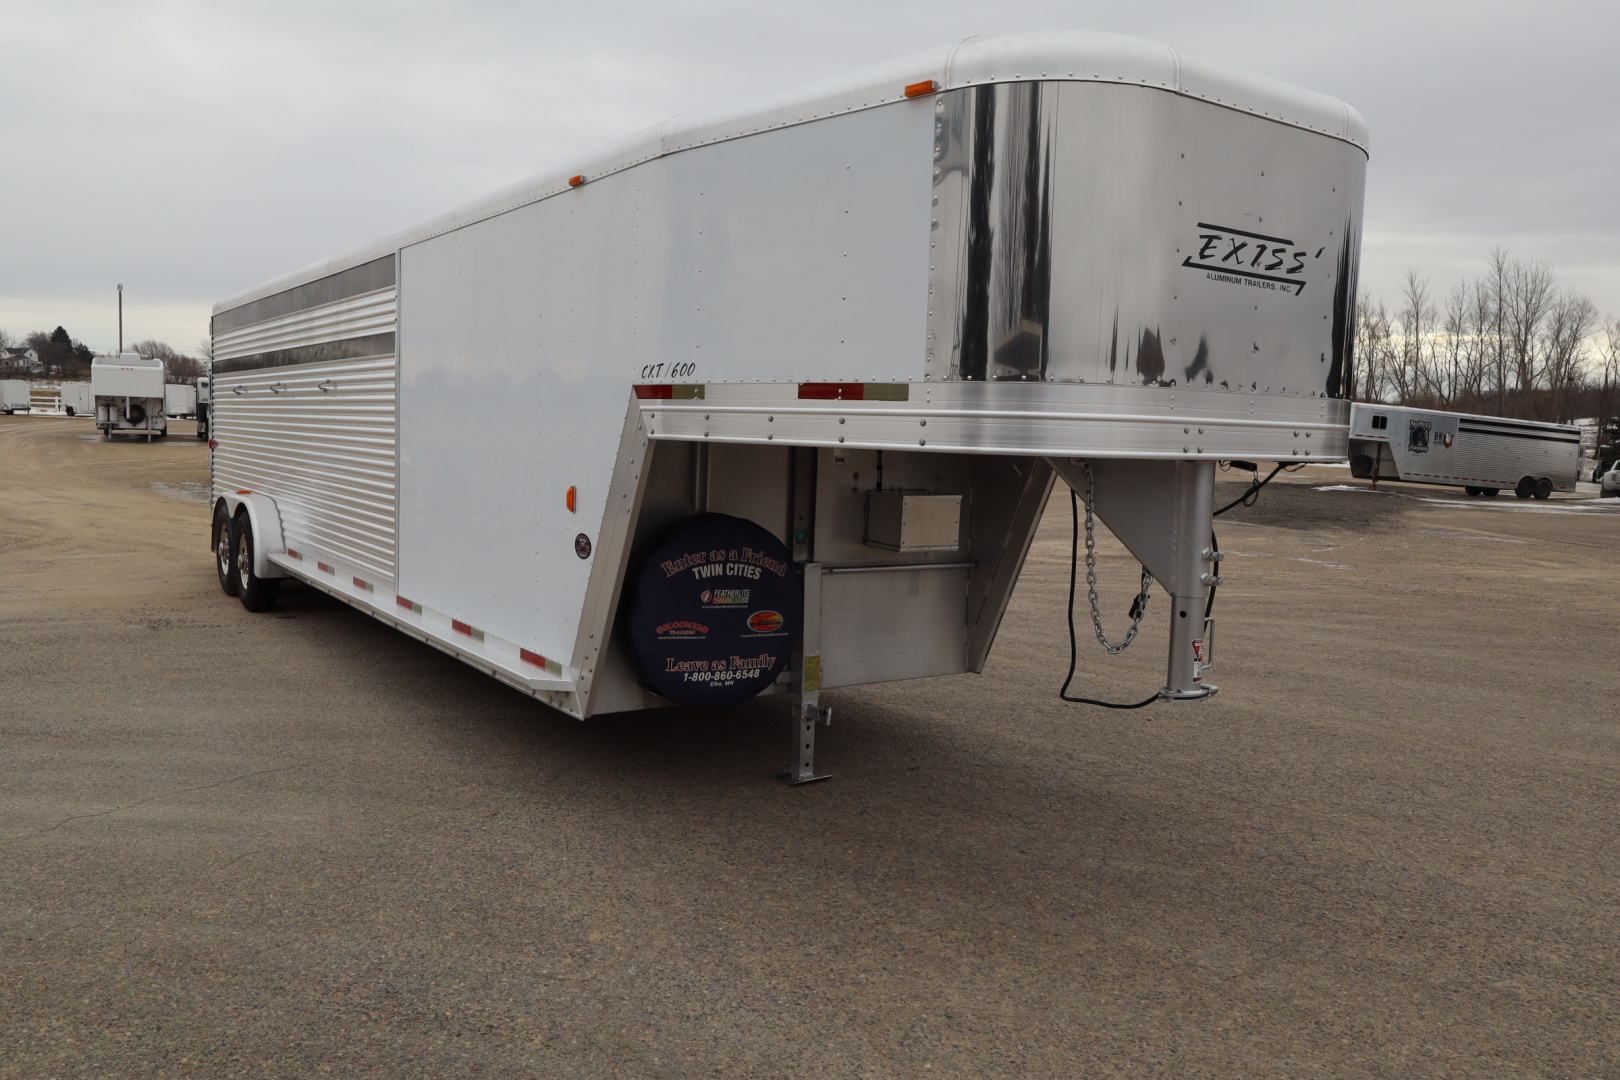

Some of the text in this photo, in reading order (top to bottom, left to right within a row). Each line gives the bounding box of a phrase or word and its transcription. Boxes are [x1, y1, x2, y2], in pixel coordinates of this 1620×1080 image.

[1206, 272, 1242, 285] ALUMINUM
[1279, 284, 1293, 293] INC.
[660, 546, 788, 578] Enter as a Friend
[691, 562, 762, 580] TWIN CITIES
[714, 589, 751, 597] FEATHERLITE
[665, 653, 777, 672] Leave as Family
[683, 668, 761, 682] 1-800-860-6548
